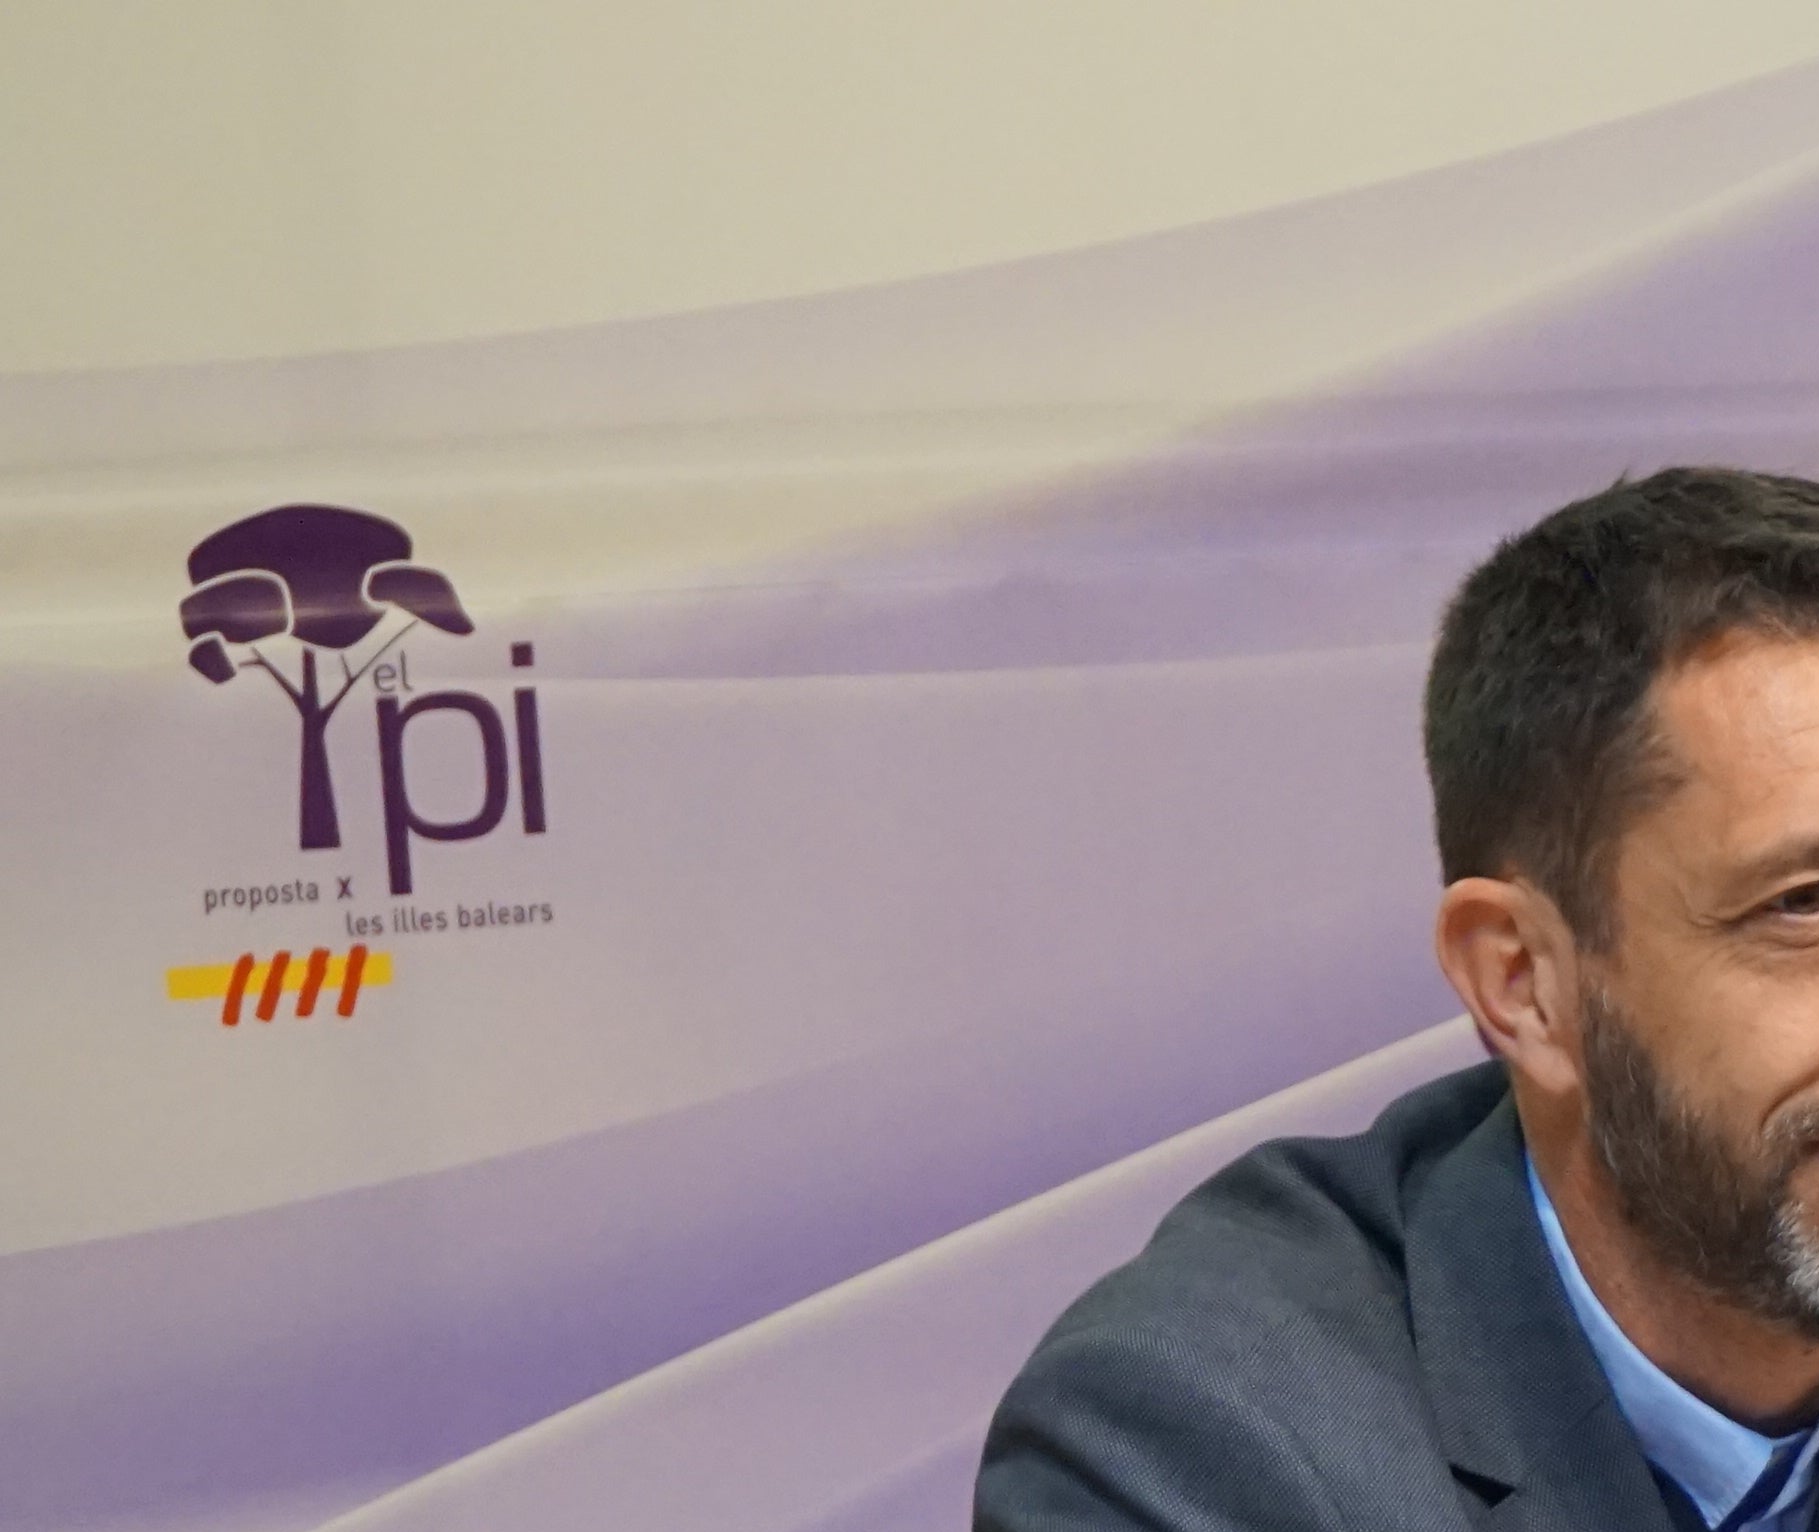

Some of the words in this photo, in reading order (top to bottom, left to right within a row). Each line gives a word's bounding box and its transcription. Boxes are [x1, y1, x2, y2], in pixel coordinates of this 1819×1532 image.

[373, 651, 413, 694] el
[376, 640, 547, 896] pi
[203, 879, 320, 915] proposta
[345, 911, 384, 937] les
[393, 906, 448, 934] illes
[457, 902, 554, 930] balears
